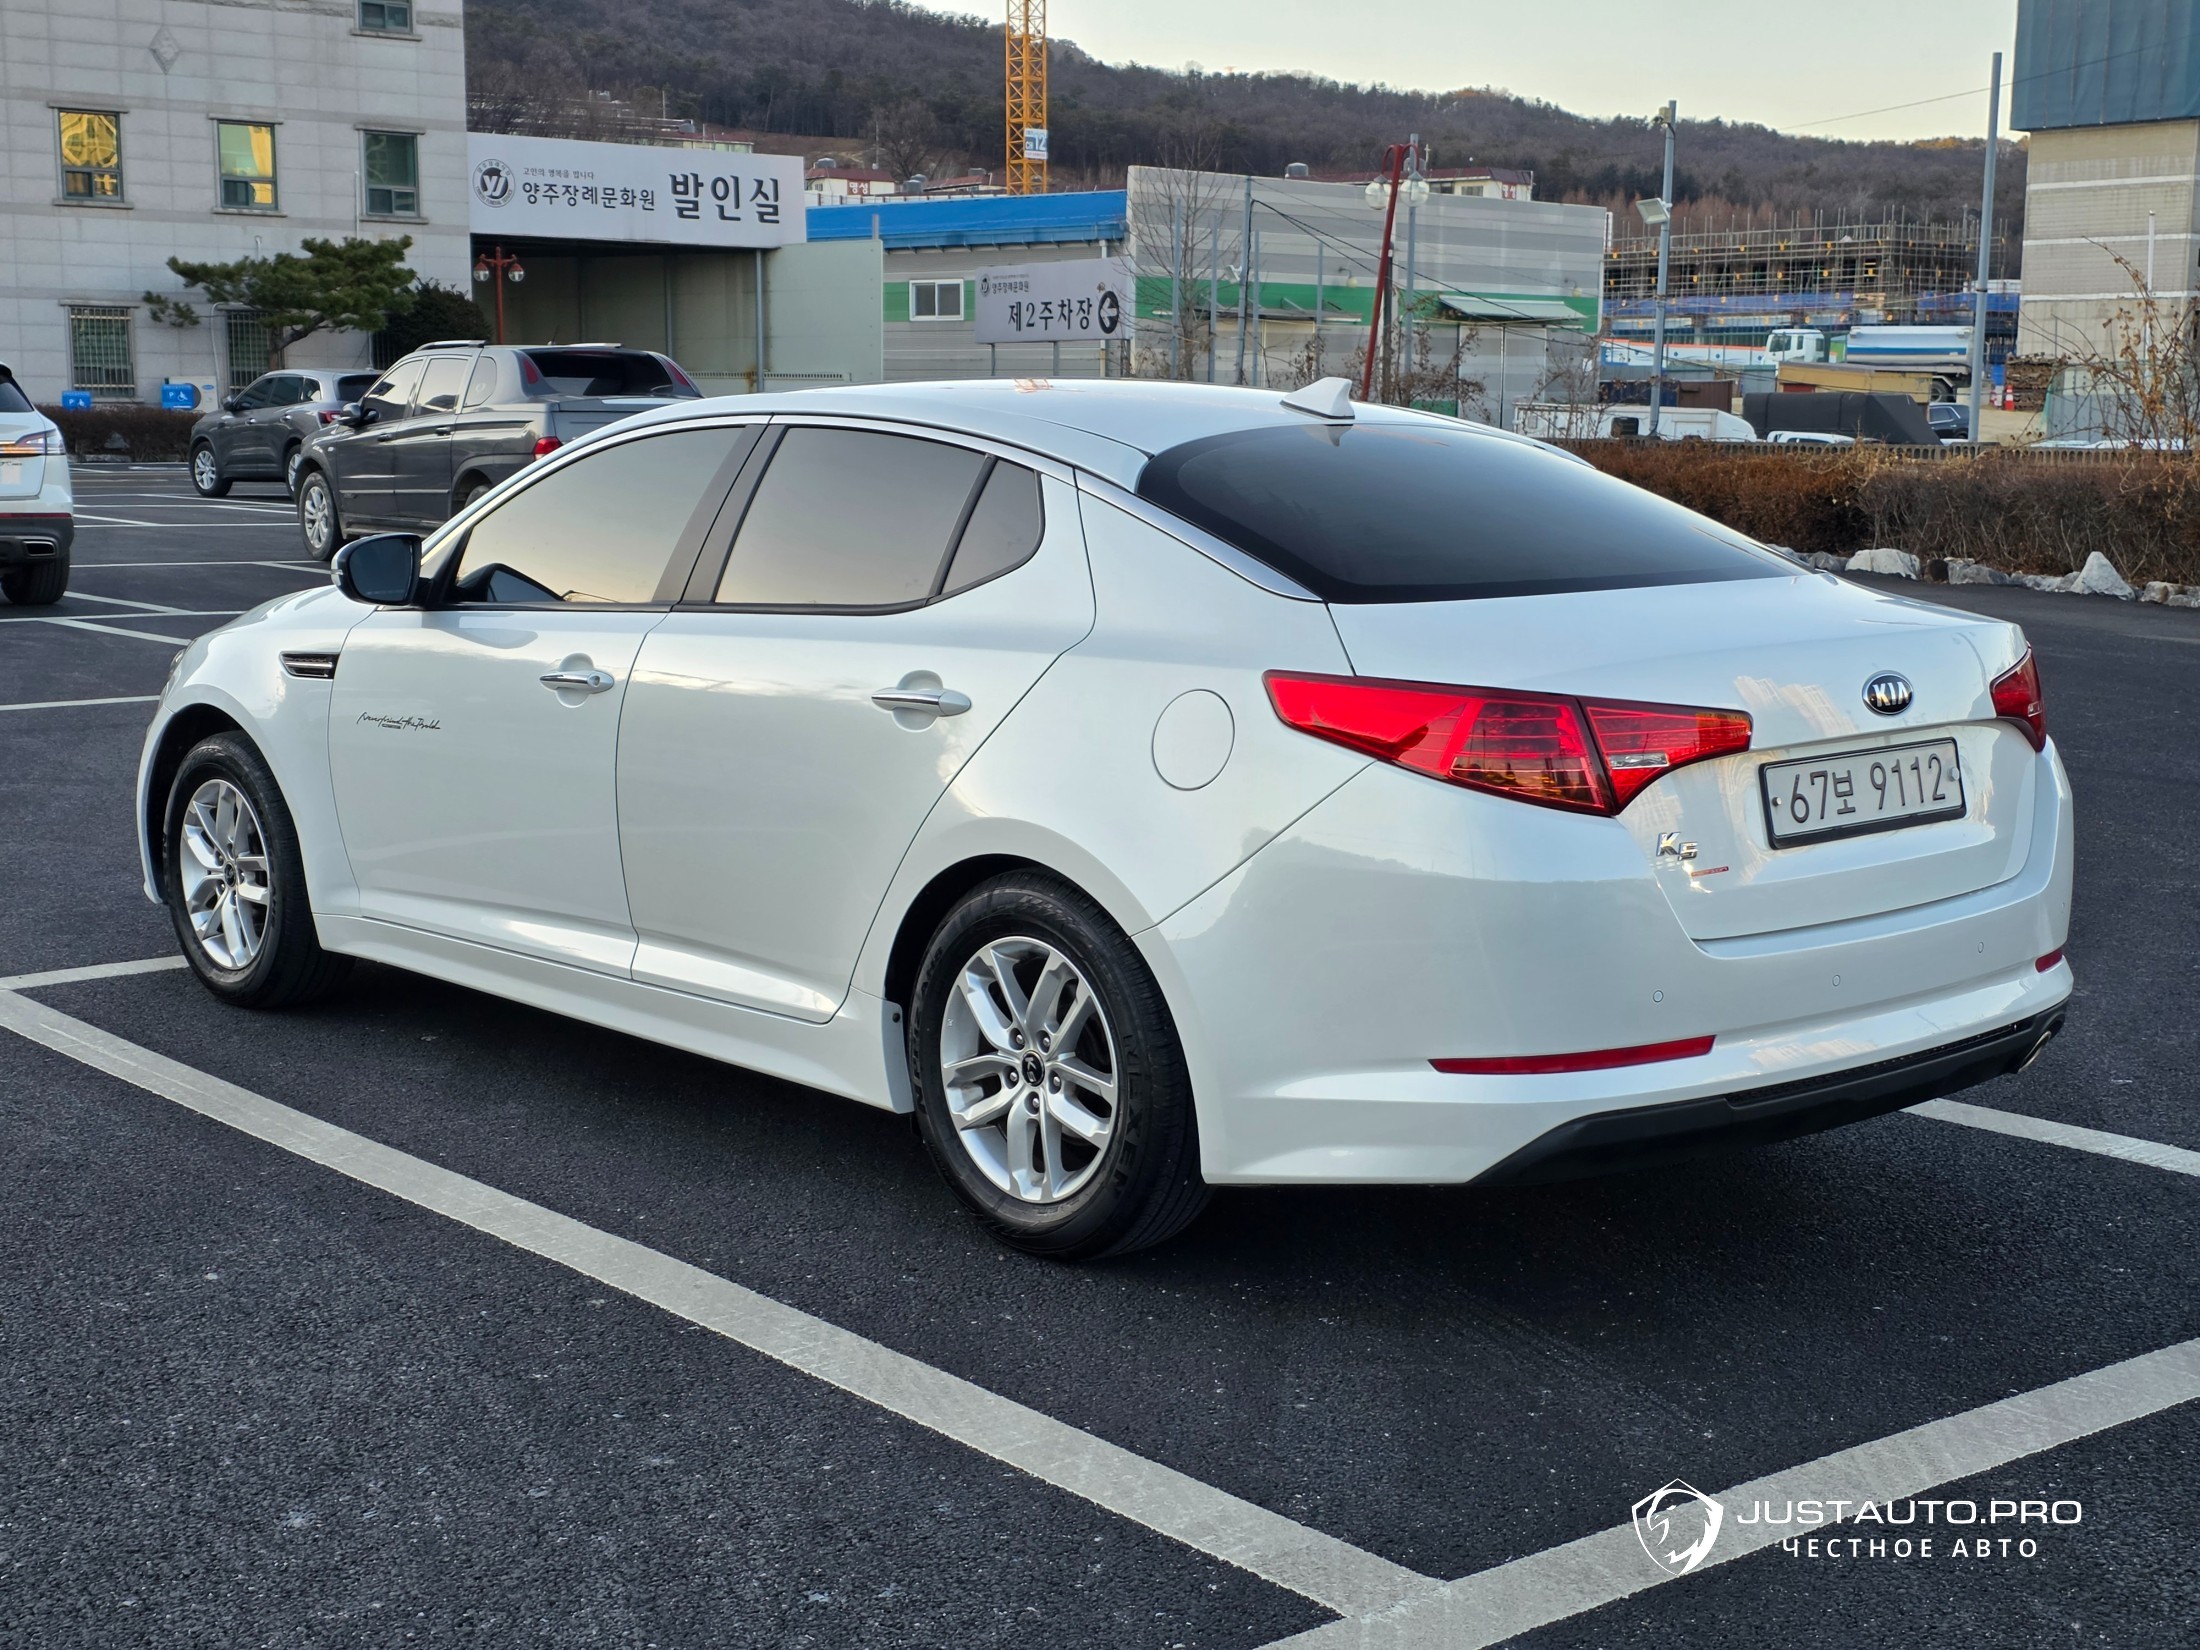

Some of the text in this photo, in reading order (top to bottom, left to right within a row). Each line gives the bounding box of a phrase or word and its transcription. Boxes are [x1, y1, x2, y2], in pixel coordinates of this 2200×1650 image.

[522, 167, 545, 177] 고인의
[521, 181, 656, 212] 양주장례문화원
[668, 172, 781, 225] 발인실
[1008, 297, 1093, 332] 제2주차장
[1871, 681, 1912, 708] KIA
[1789, 752, 1947, 824] 67보 9112
[1655, 831, 1698, 861] K5
